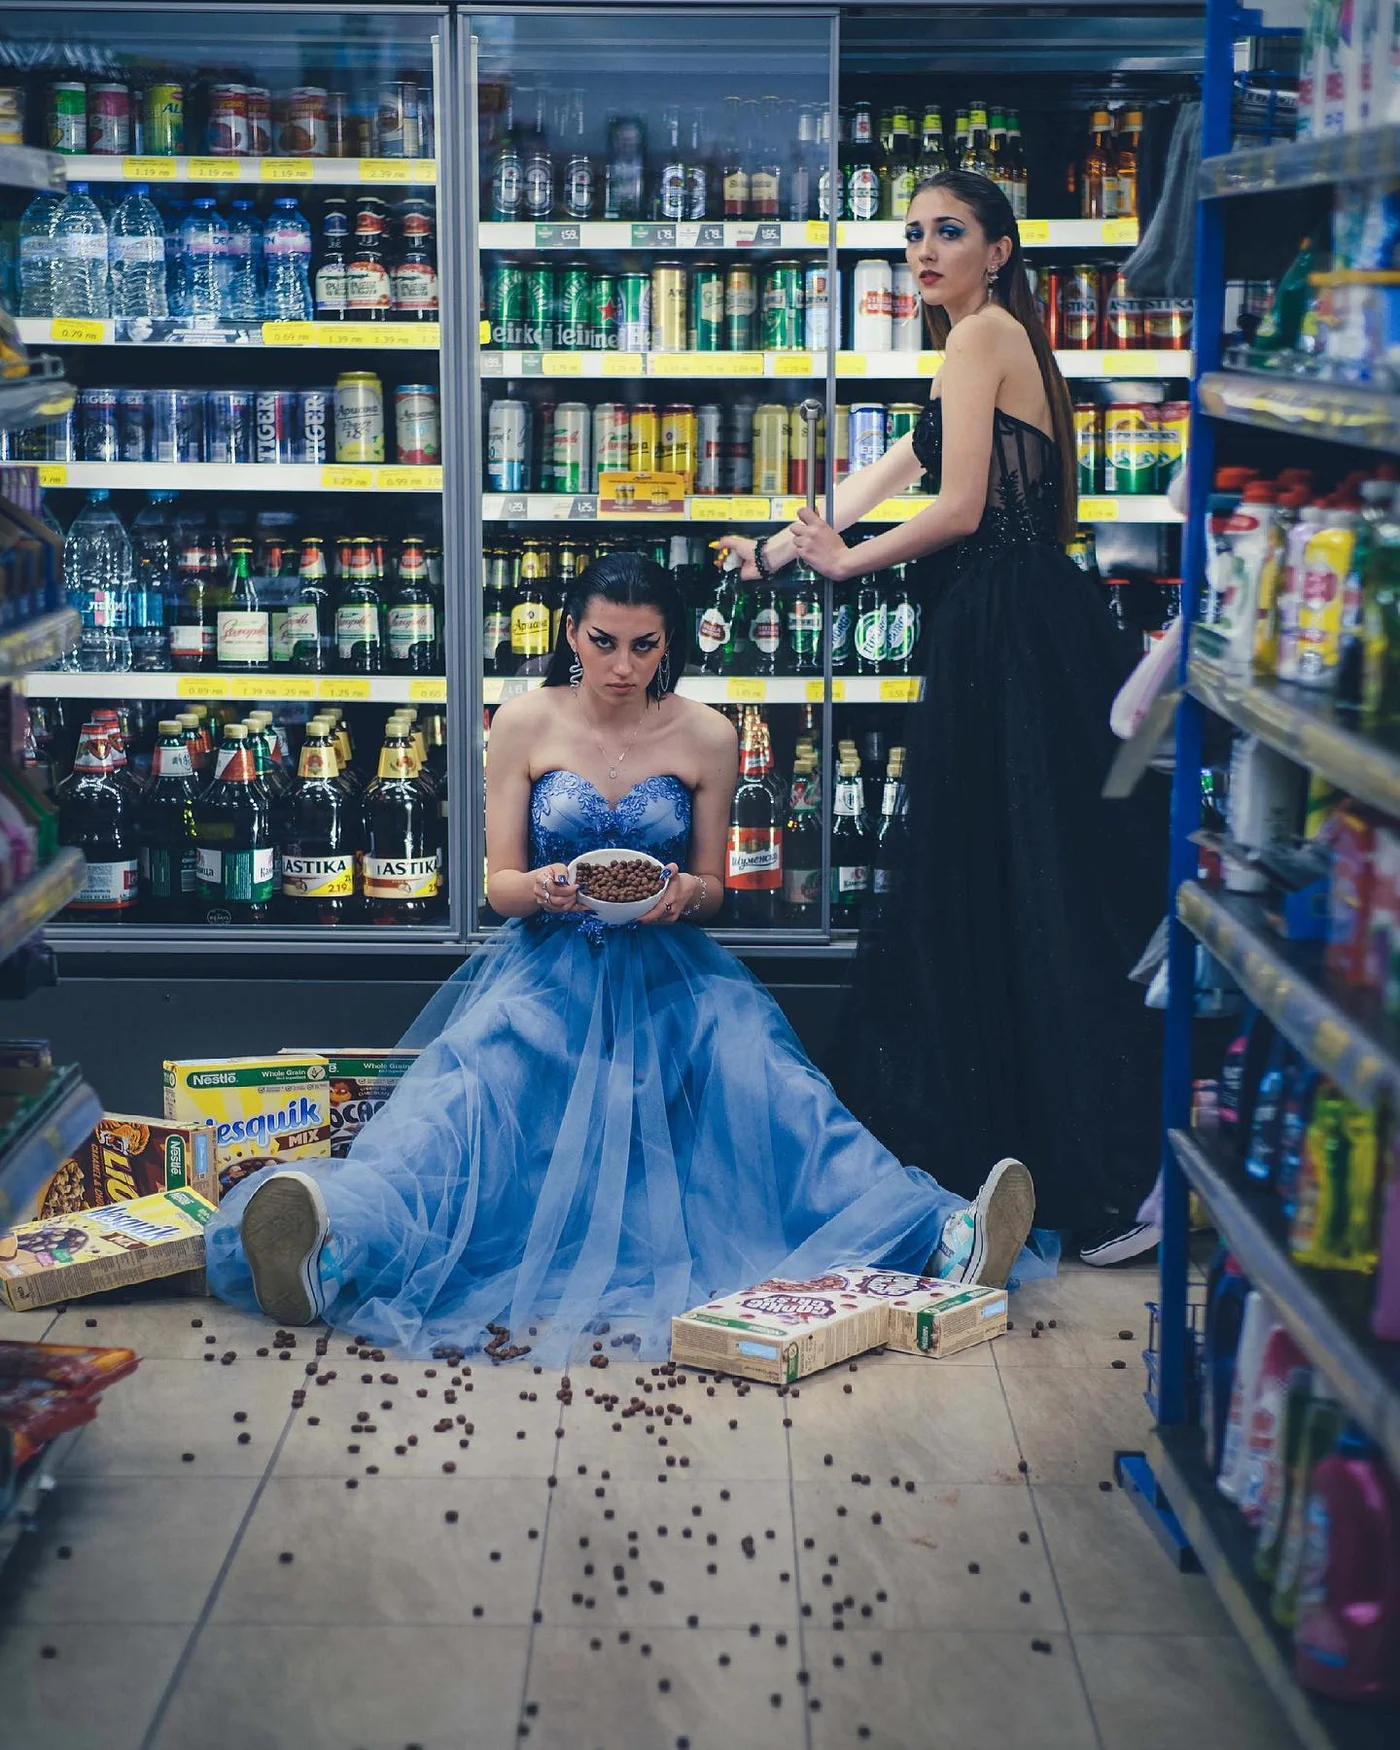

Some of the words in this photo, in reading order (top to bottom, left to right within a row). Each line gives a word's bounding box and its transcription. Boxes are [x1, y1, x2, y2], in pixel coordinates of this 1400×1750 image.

[257, 395, 276, 463] TIGER
[304, 395, 326, 463] TIGER
[284, 859, 347, 875] ASTIKA
[261, 1069, 286, 1079] Whole
[286, 1068, 307, 1077] Grain
[206, 1097, 321, 1147] esquik
[288, 1128, 320, 1148] MIX
